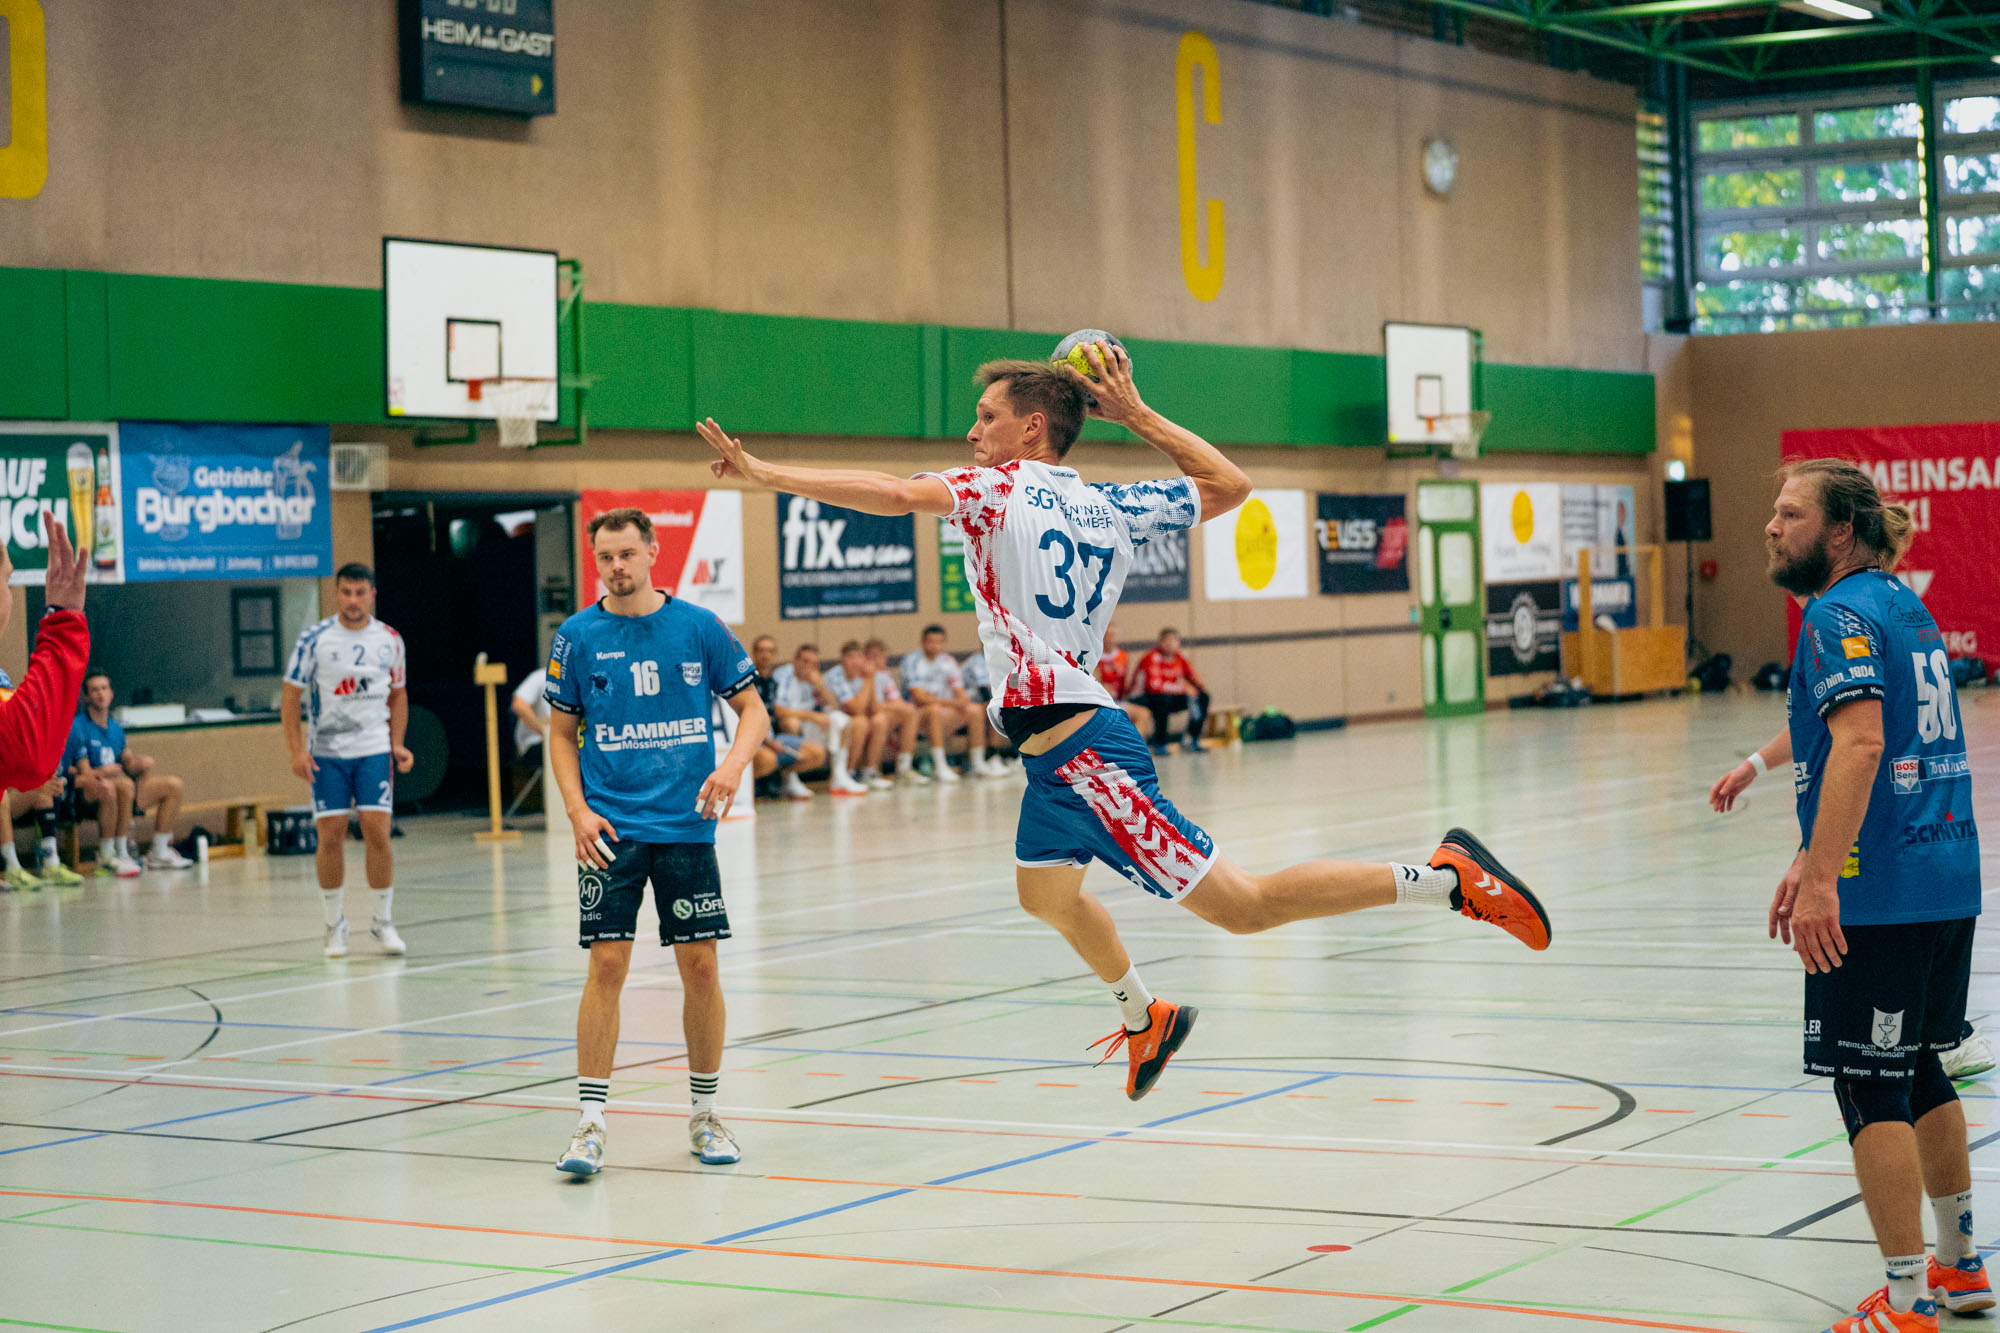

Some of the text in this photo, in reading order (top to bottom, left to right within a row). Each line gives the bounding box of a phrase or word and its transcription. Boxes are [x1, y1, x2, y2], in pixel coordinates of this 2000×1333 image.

[422, 16, 554, 56] HEIM GAST
[1177, 31, 1225, 302] C
[1025, 485, 1053, 509] SG
[136, 487, 316, 533] Burgbacher
[783, 496, 847, 569] fix
[1035, 528, 1114, 625] 37
[353, 644, 366, 666] 2
[596, 651, 625, 660] Kempa
[630, 660, 661, 696] 16
[1835, 689, 1864, 701] Kempa
[595, 717, 707, 742] FLAMMER
[622, 739, 681, 750] Mössingen
[378, 780, 391, 805] 2
[580, 882, 599, 905] MJ
[1930, 1041, 1956, 1051] Kempa
[1811, 1062, 1835, 1073] Kempa
[1843, 1066, 1872, 1076] Kempa
[1887, 1258, 1924, 1267] Kempa
